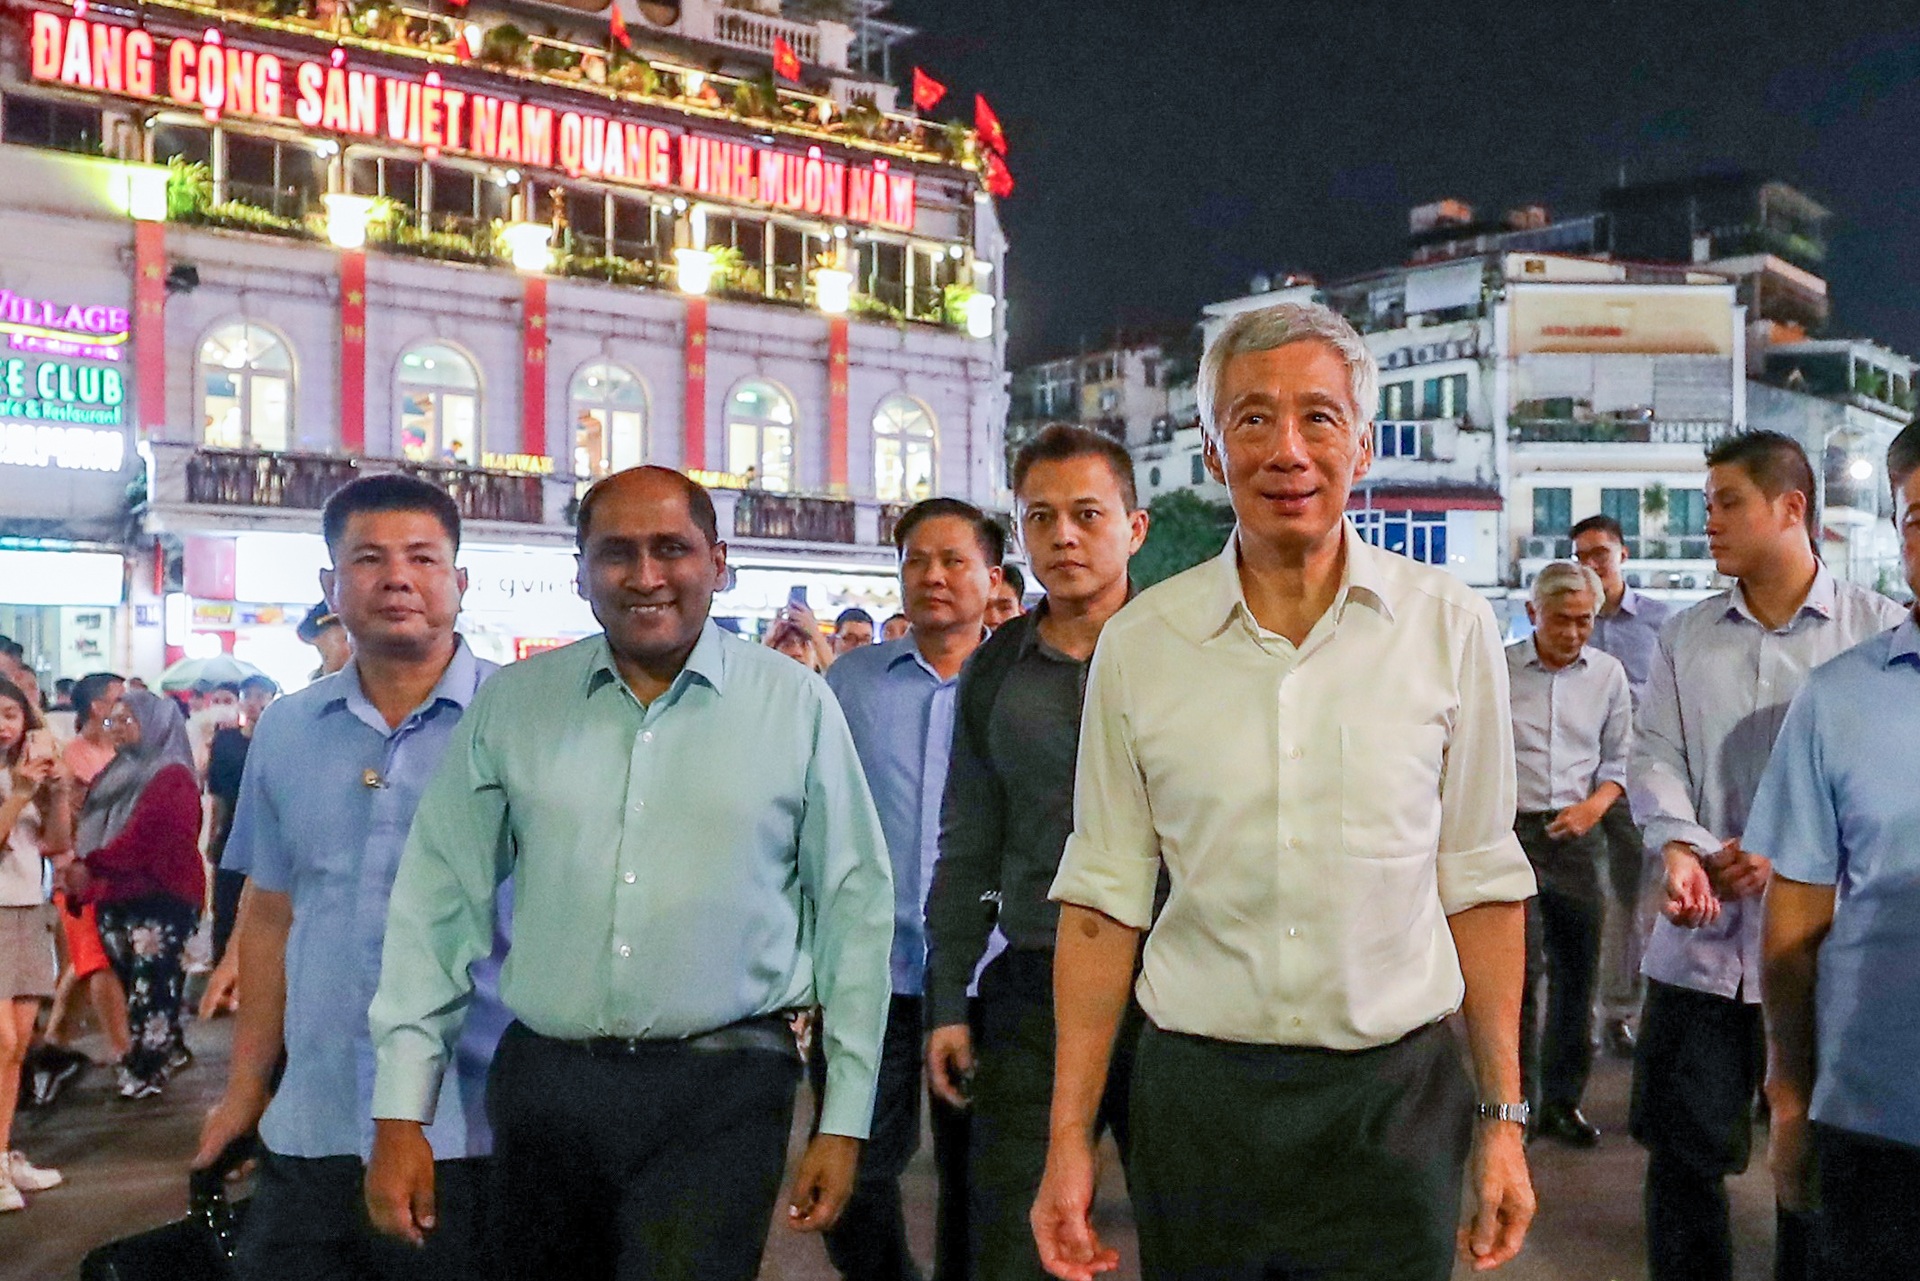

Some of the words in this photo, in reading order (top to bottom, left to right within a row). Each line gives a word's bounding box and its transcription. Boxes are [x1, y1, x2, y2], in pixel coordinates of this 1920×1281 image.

[31, 0, 155, 98] ĐẢNG
[169, 26, 282, 122] CỘNG
[296, 48, 377, 135] SẢN
[385, 71, 465, 159] VIỆT
[471, 94, 555, 167] NAM
[559, 111, 671, 188] QUANG
[679, 134, 752, 199] VINH
[758, 145, 845, 217] MUÔN
[848, 158, 915, 231] NĂM
[0, 357, 25, 398] E
[37, 361, 123, 406] CLUB
[42, 400, 121, 425] Restaurant
